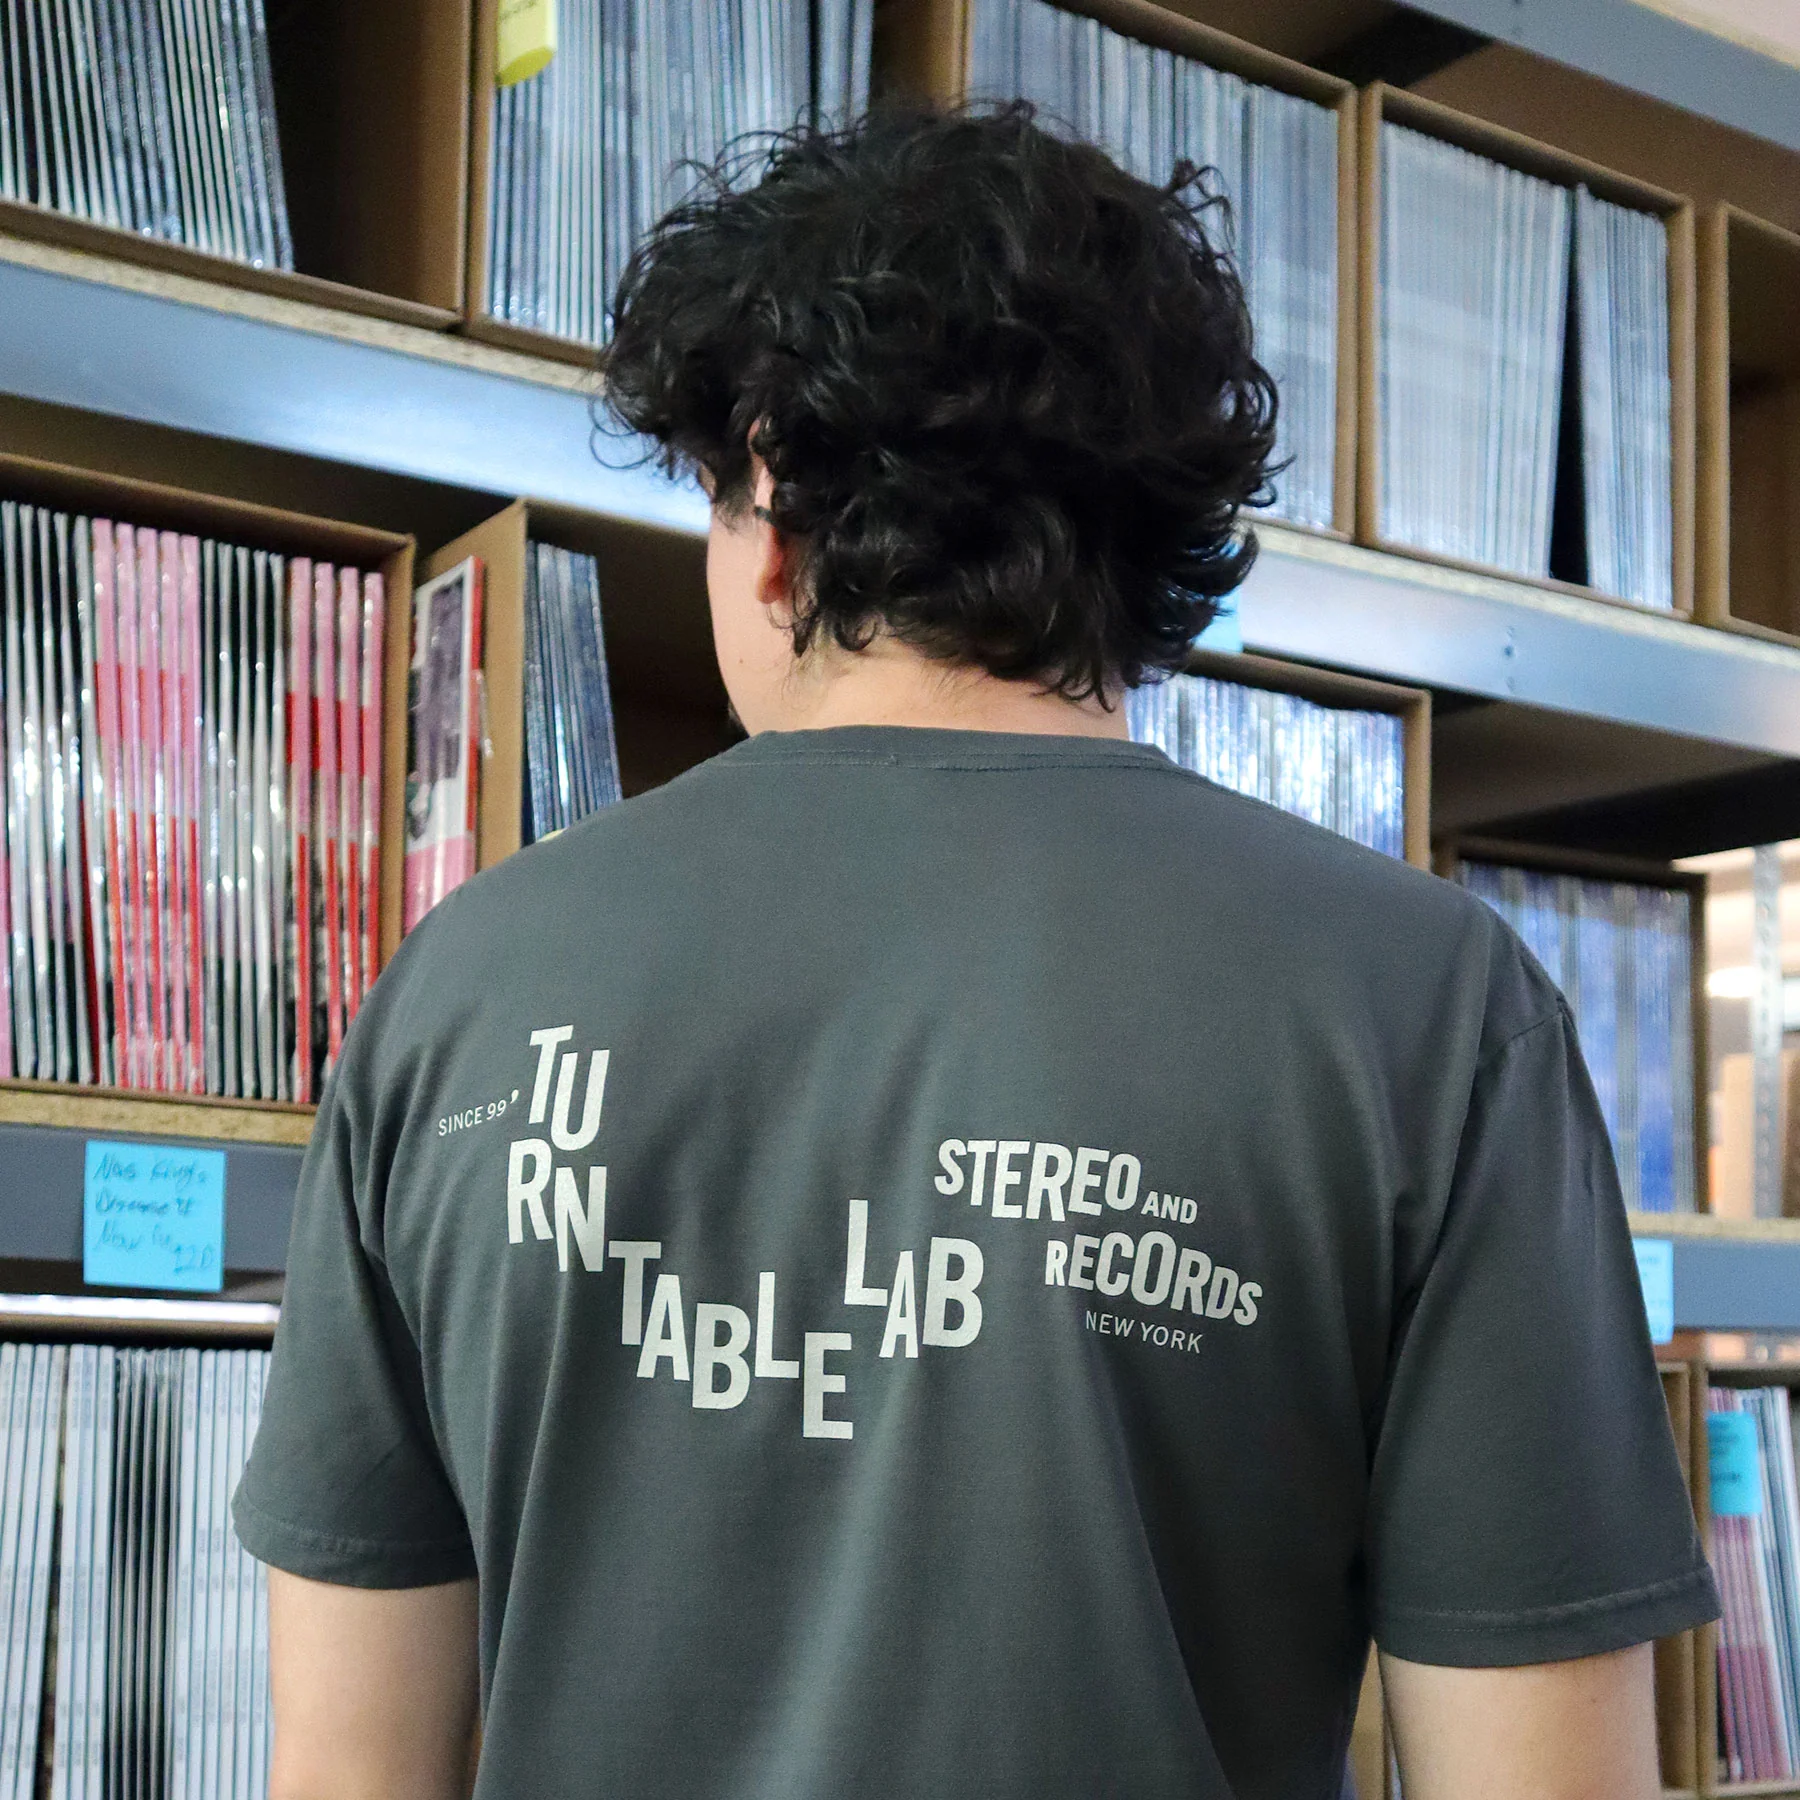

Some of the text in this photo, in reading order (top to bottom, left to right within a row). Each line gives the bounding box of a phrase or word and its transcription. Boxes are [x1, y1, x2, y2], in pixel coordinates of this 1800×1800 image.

[438, 1105, 484, 1137] SINCE
[933, 1138, 1199, 1225] STEREO AND
[843, 1199, 985, 1359] LAB
[1044, 1231, 1264, 1326] RECORDS
[1085, 1310, 1204, 1354] NEW YORK
